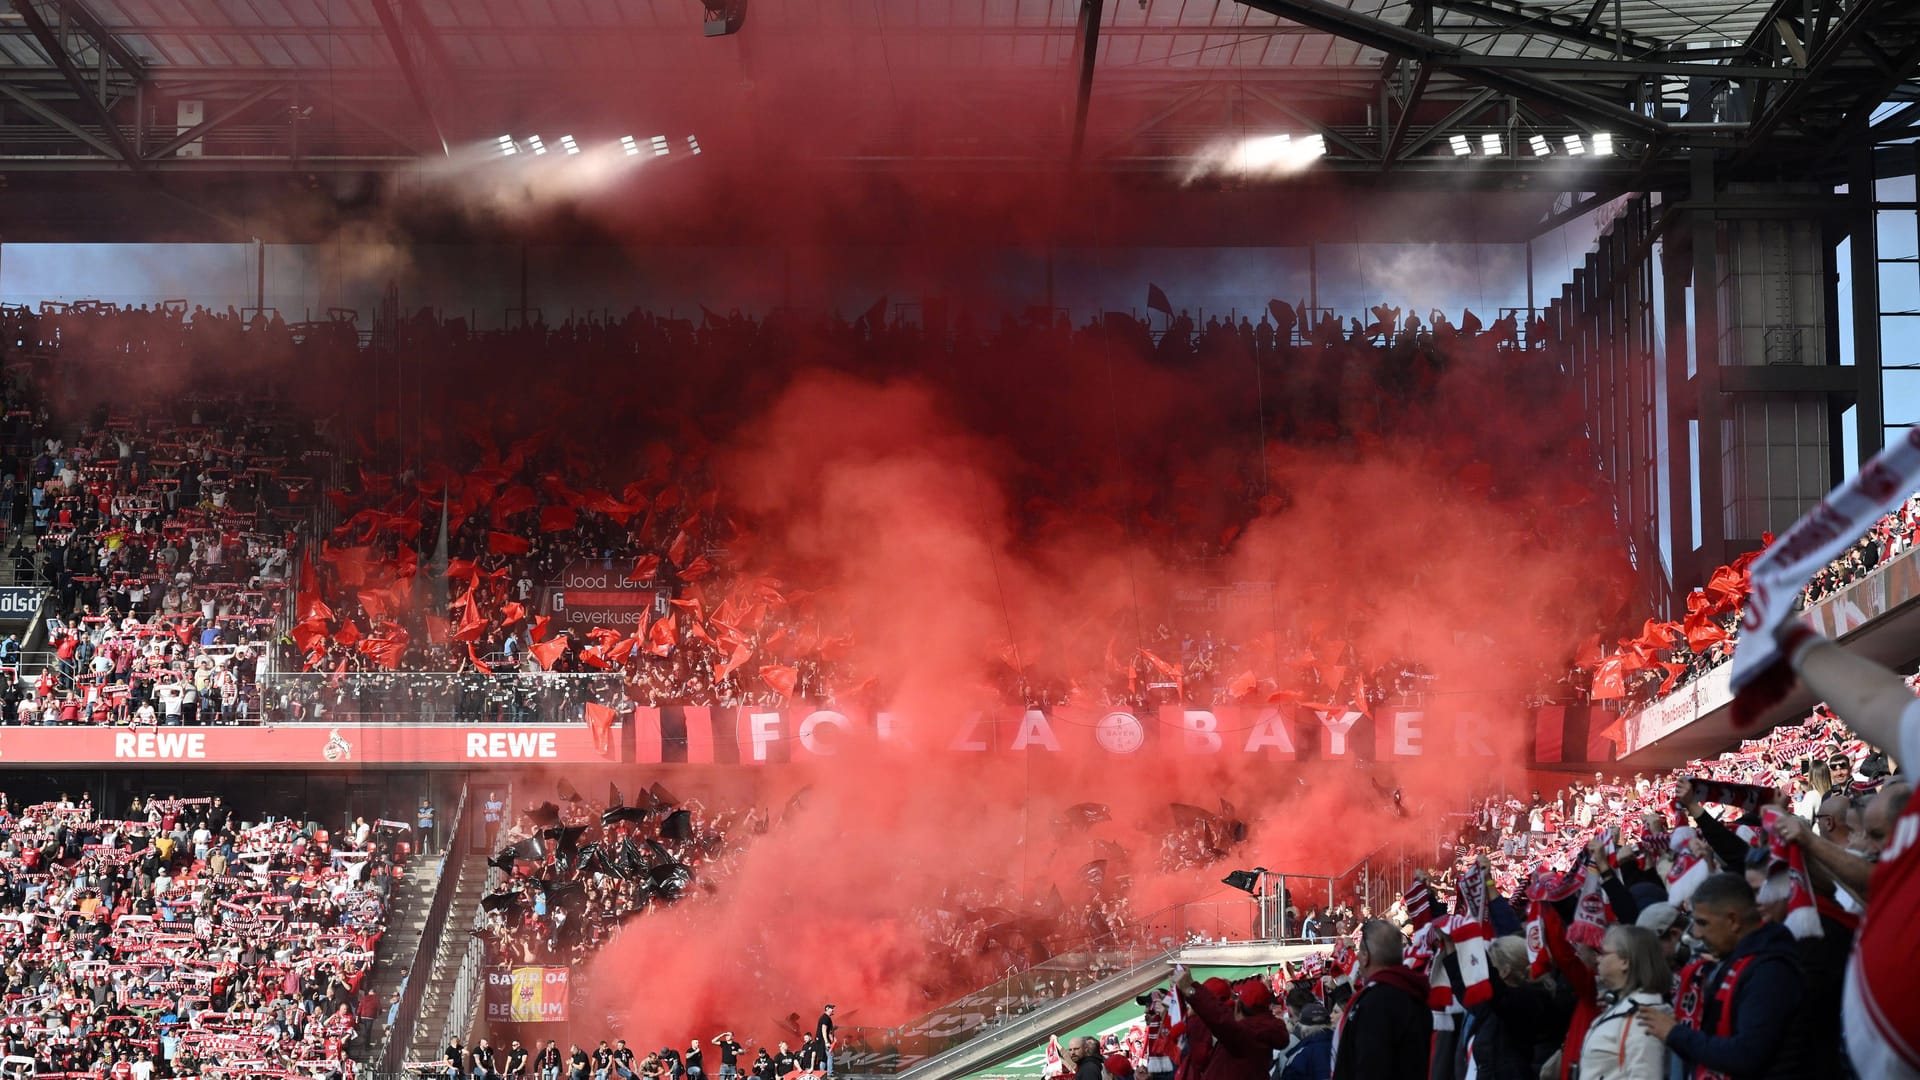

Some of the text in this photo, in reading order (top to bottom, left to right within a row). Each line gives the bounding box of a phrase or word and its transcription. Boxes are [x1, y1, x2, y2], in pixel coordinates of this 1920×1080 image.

[566, 574, 606, 589] Jood
[115, 732, 206, 758] REWE
[466, 732, 557, 758] REWE
[1184, 710, 1494, 757] BAYER
[489, 1003, 562, 1016] BELGIUM
